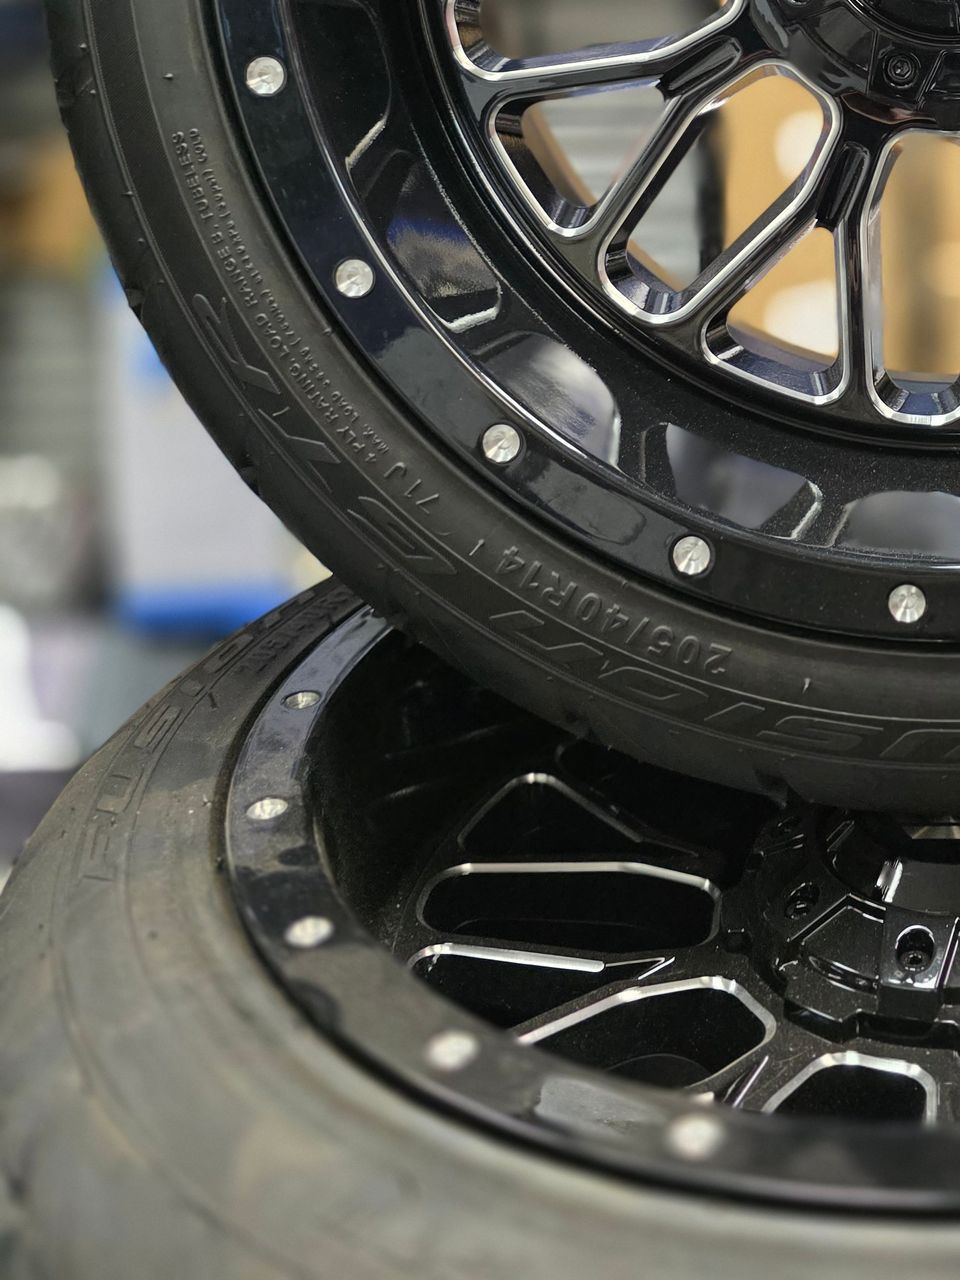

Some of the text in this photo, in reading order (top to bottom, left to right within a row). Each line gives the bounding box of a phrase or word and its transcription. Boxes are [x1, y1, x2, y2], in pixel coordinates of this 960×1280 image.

[171, 130, 213, 220] TUBELESS
[216, 245, 258, 307] RANGE
[255, 311, 289, 358] LOAD
[331, 389, 359, 424] LOAD
[335, 424, 366, 454] PLY
[497, 546, 731, 675] 205/40R14
